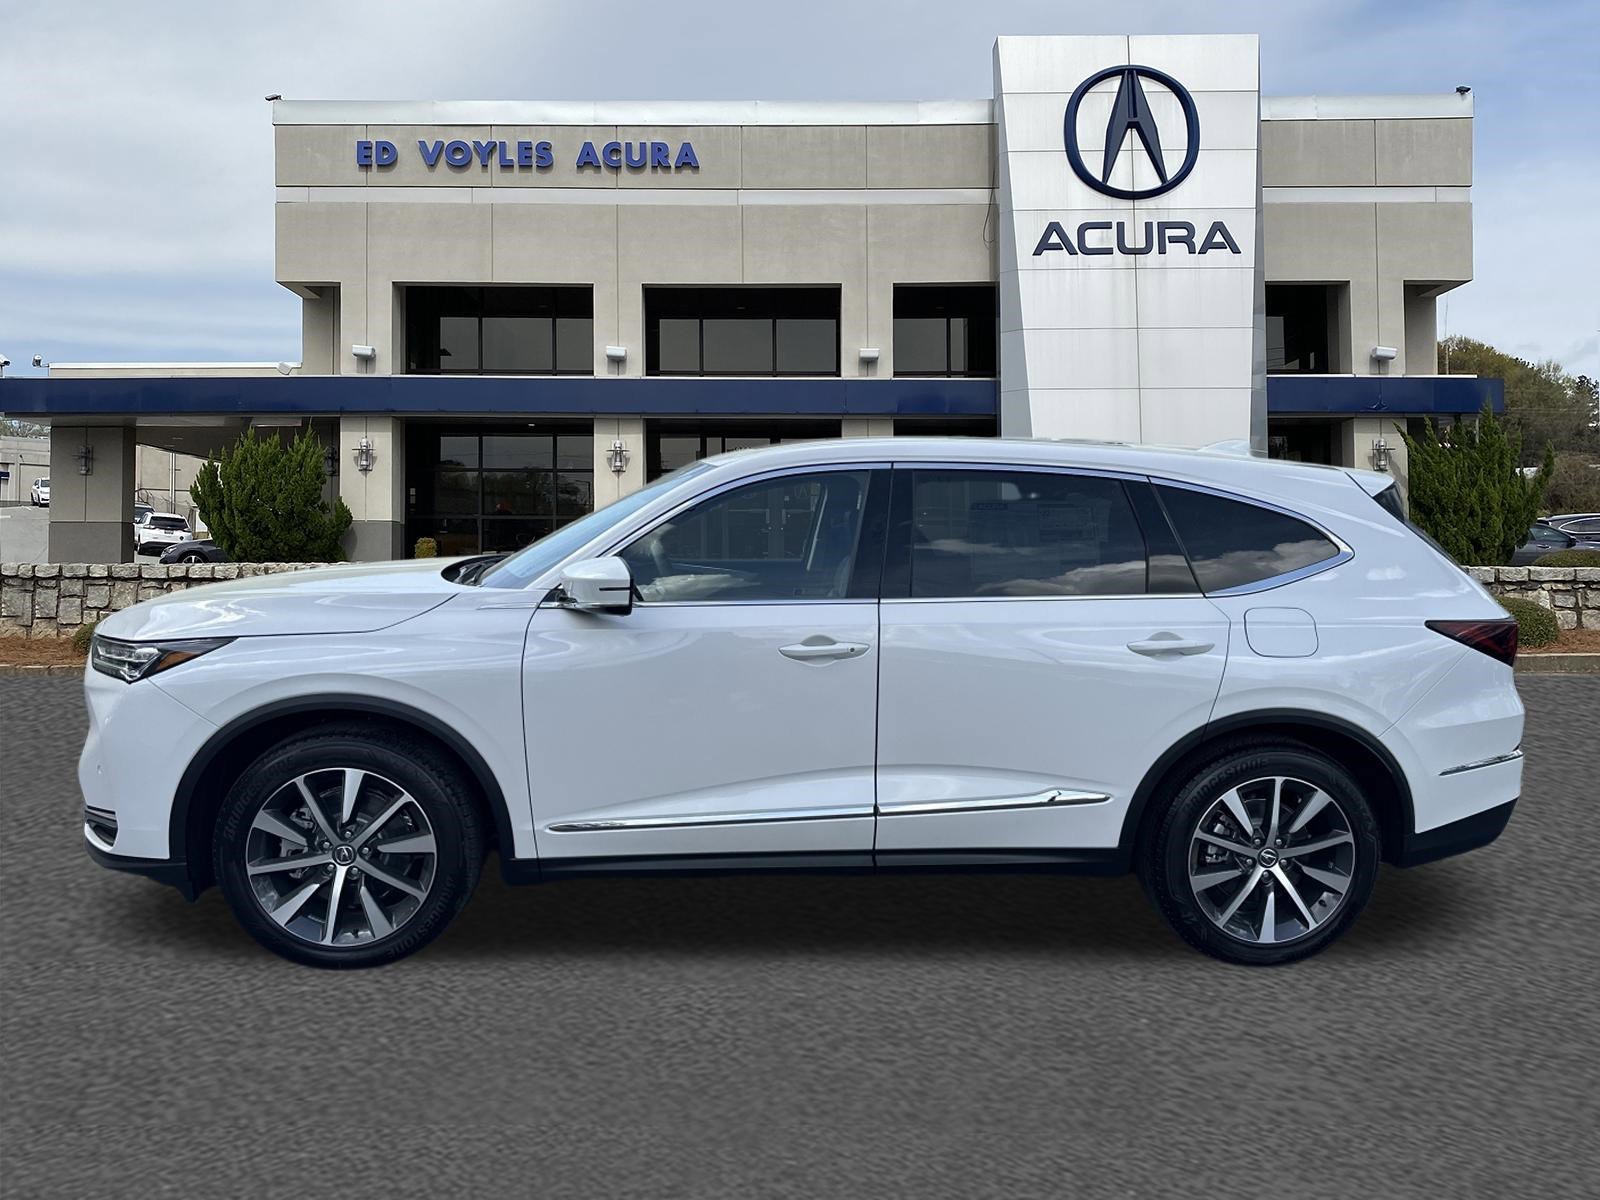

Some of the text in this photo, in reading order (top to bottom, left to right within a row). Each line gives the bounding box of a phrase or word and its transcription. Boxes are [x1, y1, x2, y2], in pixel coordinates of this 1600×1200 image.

[356, 140, 700, 168] ED VOYLES ACURA
[1032, 221, 1242, 256] ACURA
